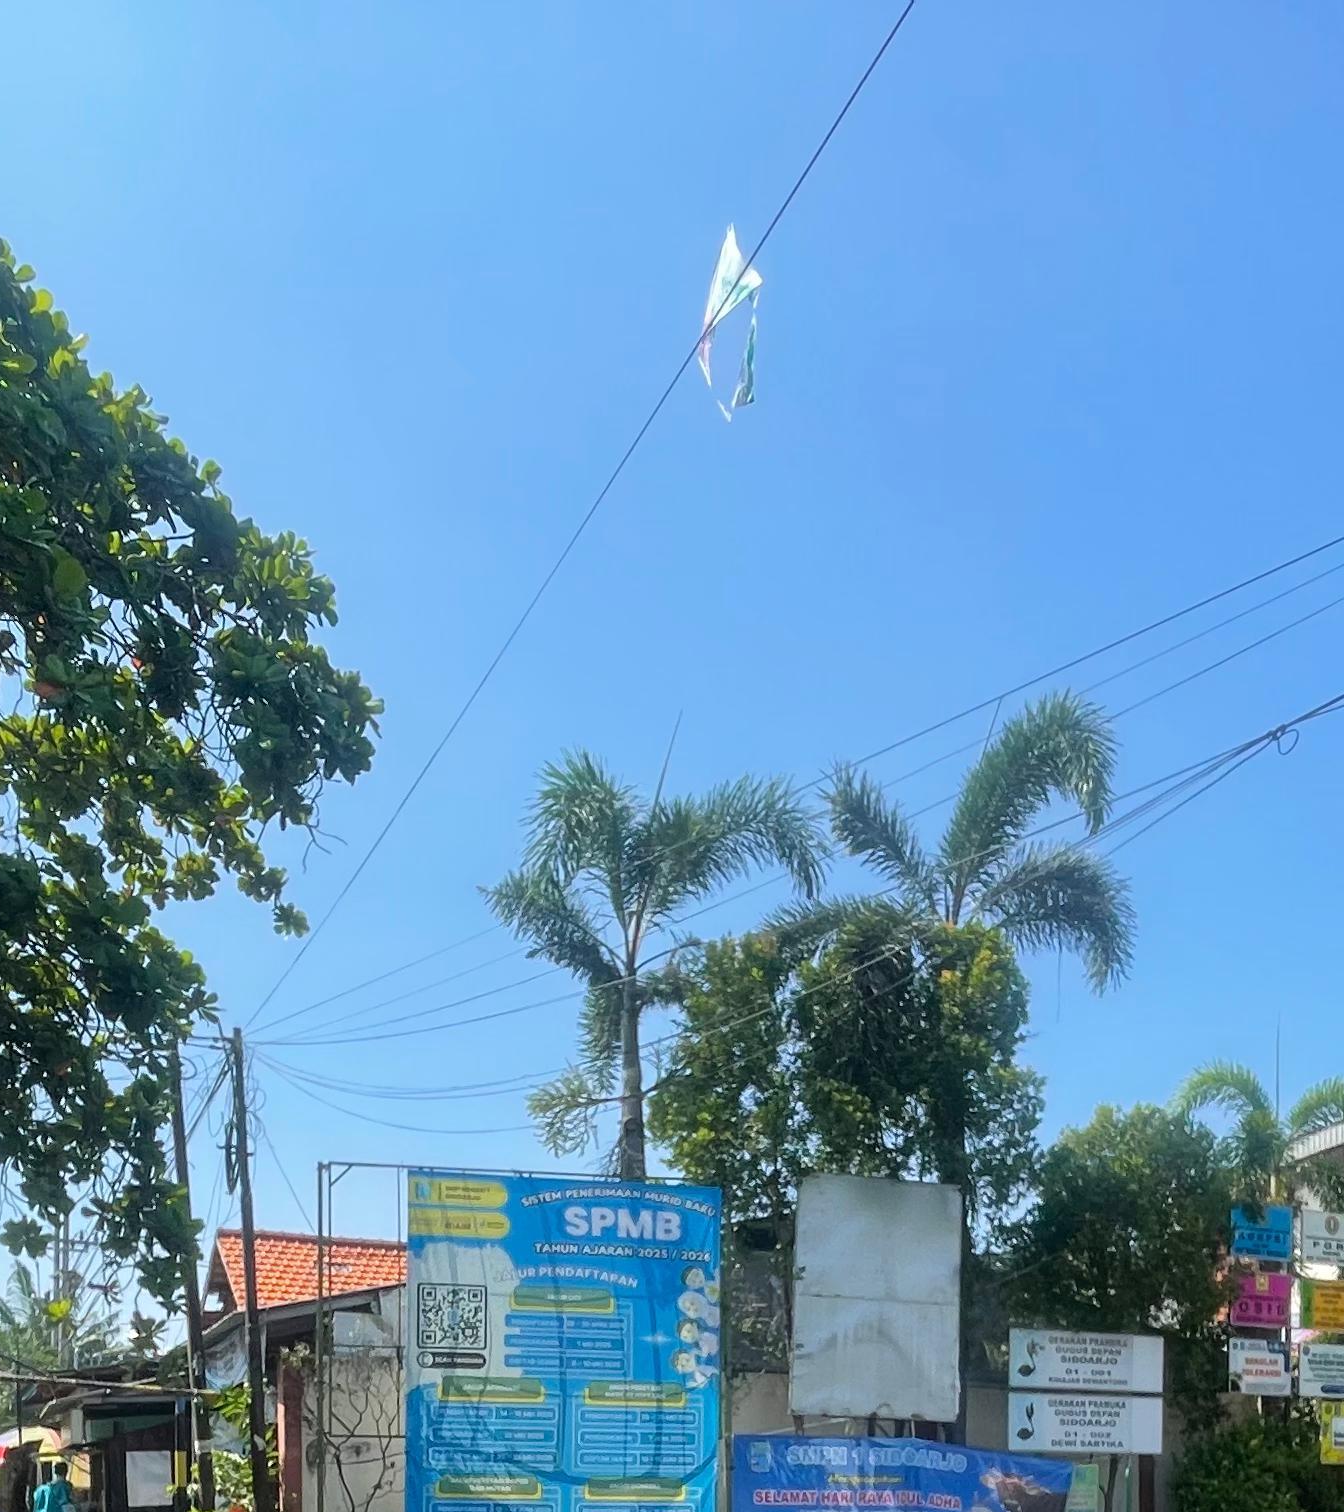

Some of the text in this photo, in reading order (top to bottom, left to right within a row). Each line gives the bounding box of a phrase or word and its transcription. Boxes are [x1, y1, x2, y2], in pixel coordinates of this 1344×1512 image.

[520, 1188, 717, 1218] SISTEM PENERIMAAN MURID BAKU
[563, 1205, 682, 1241] SPMB
[534, 1242, 580, 1255] TAHUN
[582, 1244, 633, 1257] AJARAN
[635, 1246, 668, 1259] 2025
[680, 1249, 712, 1262] 2026
[538, 1266, 639, 1289] PENDAFTARAN
[1060, 1355, 1118, 1365] SIDOARJO
[1059, 1418, 1117, 1428] SIDOARJO
[1051, 1439, 1124, 1449] DEWI SARTIKA
[787, 1445, 847, 1466] SMPN
[868, 1445, 968, 1473] SIDOARJO
[753, 1489, 962, 1510] SELAMAT HARI RAYA IDUL ADHA
